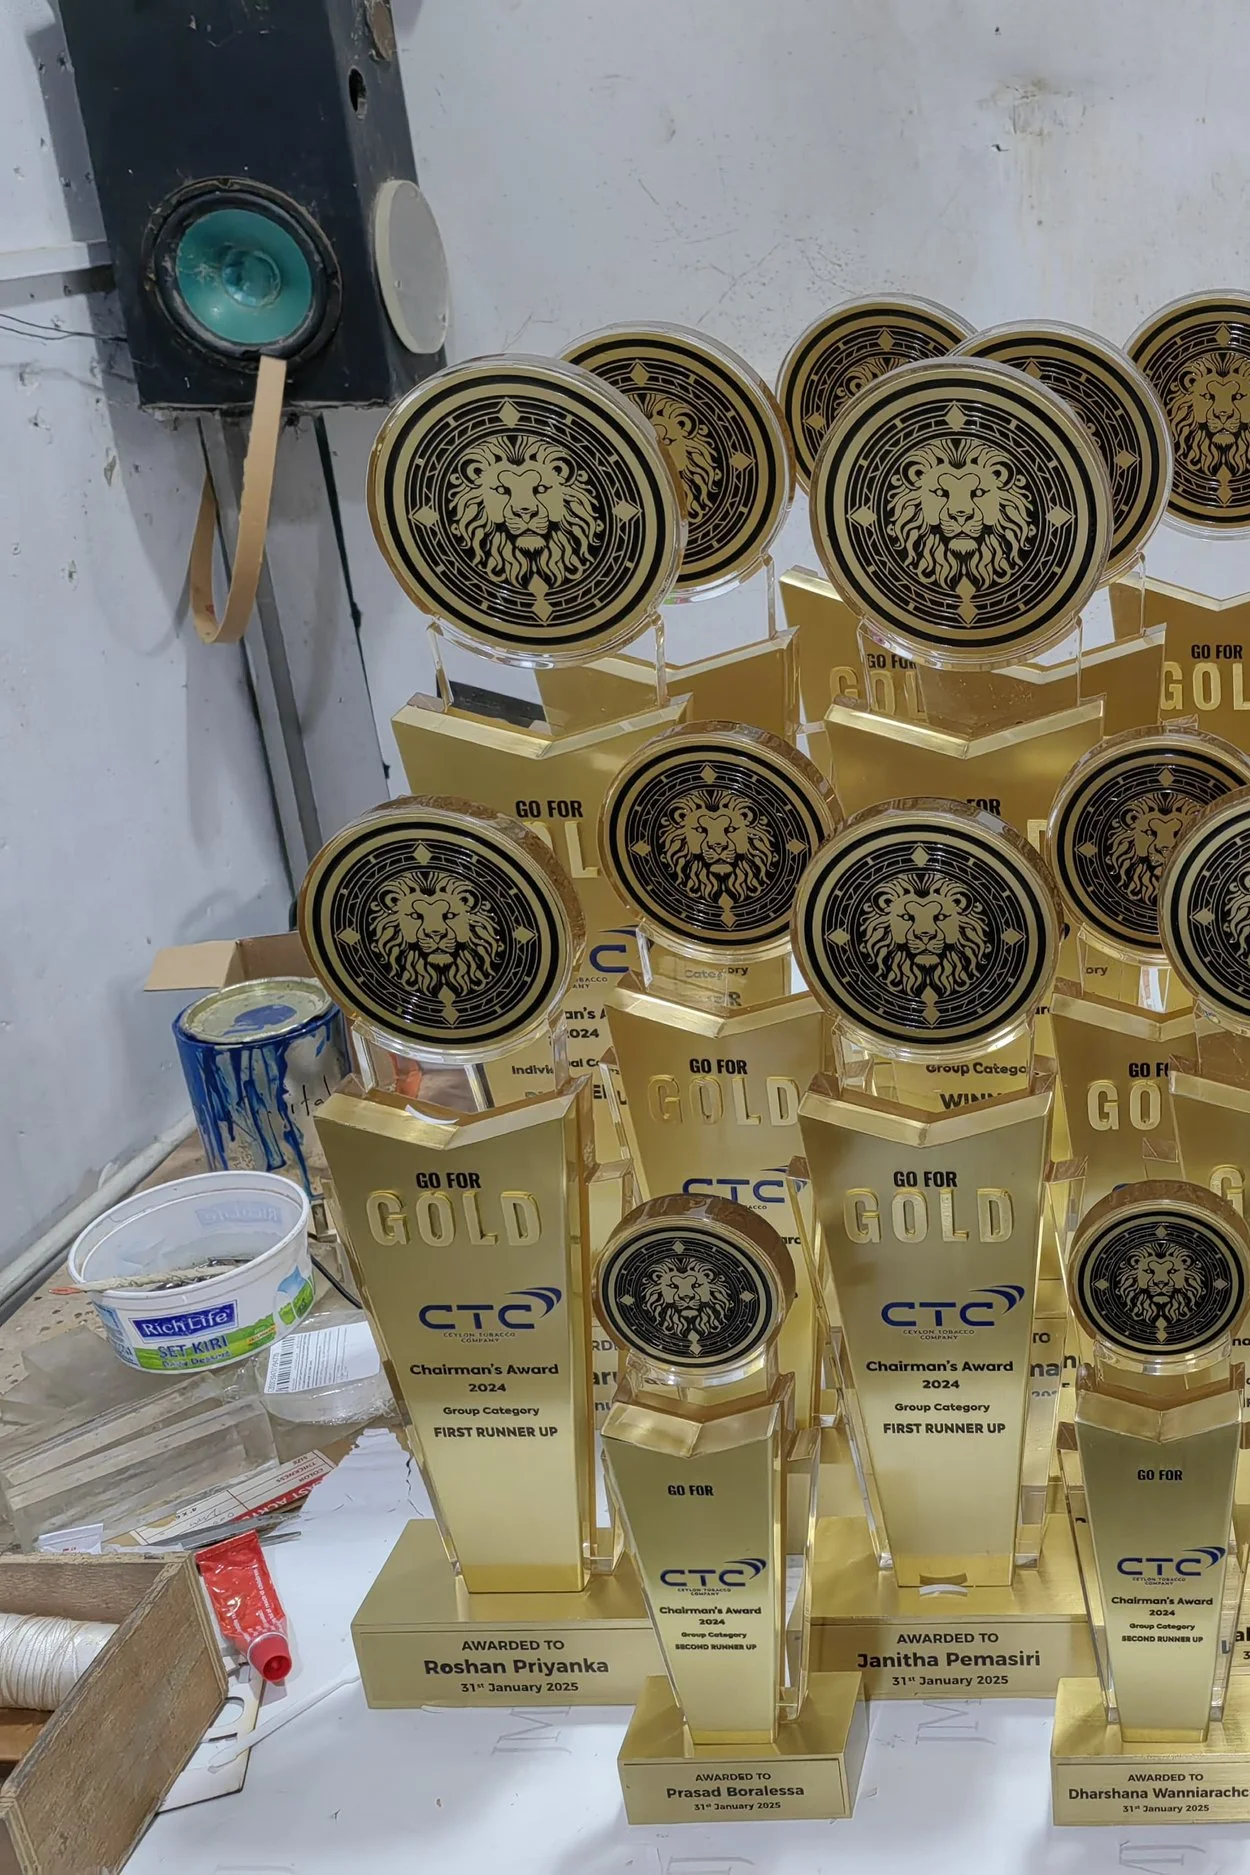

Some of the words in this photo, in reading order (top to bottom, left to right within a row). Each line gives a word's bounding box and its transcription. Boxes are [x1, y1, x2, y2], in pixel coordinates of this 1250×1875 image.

[1190, 644, 1211, 660] GO
[1215, 644, 1243, 660] FOR
[866, 653, 887, 669] GO
[515, 800, 542, 819] GO
[546, 799, 584, 818] FOR
[689, 1058, 712, 1075] GO
[716, 1058, 748, 1075] FOR
[647, 1074, 800, 1126] GOLD
[415, 1172, 441, 1189] GO
[445, 1172, 482, 1189] FOR
[893, 1170, 918, 1188] GO
[923, 1170, 958, 1188] FOR
[366, 1189, 543, 1248] GOLD
[843, 1188, 1016, 1244] GOLD
[418, 1304, 535, 1330] CTC
[880, 1301, 995, 1327] CTC
[157, 1344, 186, 1359] SET
[191, 1335, 228, 1355] KIRI
[409, 1363, 504, 1376] Chairman's
[506, 1363, 559, 1375] Award
[865, 1359, 958, 1372] Chairman's
[961, 1360, 1014, 1372] Award
[468, 1382, 507, 1393] 2024
[922, 1379, 961, 1389] 2024
[442, 1406, 481, 1417] Group
[482, 1406, 540, 1417] Category
[894, 1402, 932, 1413] Group
[933, 1402, 991, 1414] Category
[433, 1426, 474, 1438] FIRST
[475, 1426, 537, 1438] RUNNER
[538, 1426, 558, 1438] UP
[883, 1422, 923, 1434] FIRST
[924, 1422, 984, 1434] RUNNER
[986, 1422, 1006, 1434] UP
[1137, 1469, 1155, 1481] GO
[1158, 1469, 1183, 1481] FOR
[667, 1484, 686, 1496] GO
[688, 1484, 714, 1497] FOR
[1116, 1557, 1202, 1577] CTC
[659, 1569, 746, 1587] CTC
[1110, 1596, 1175, 1605] Chairman's
[1176, 1597, 1214, 1606] Award
[1148, 1609, 1176, 1617] 2024
[896, 1632, 975, 1645] AWARDED
[978, 1632, 999, 1644] TO
[461, 1640, 541, 1652] AWARDED
[543, 1639, 565, 1651] TO
[857, 1651, 939, 1668] Janitha
[945, 1650, 1041, 1667] Pemasiri
[423, 1658, 507, 1675] Roshan
[512, 1657, 609, 1677] Priyanka
[919, 1676, 973, 1687] January
[976, 1675, 1009, 1685] 2025
[487, 1682, 543, 1694] January
[545, 1682, 579, 1692] 2025
[695, 1772, 754, 1782] AWARDED
[755, 1772, 772, 1781] TO
[1127, 1773, 1186, 1782] AWARDED
[1188, 1773, 1204, 1782] TO
[666, 1786, 722, 1799] Prasad
[726, 1785, 805, 1797] Boralessa
[1068, 1787, 1149, 1800] Dharshana
[1142, 1805, 1184, 1814] January
[1185, 1804, 1210, 1812] 2025
